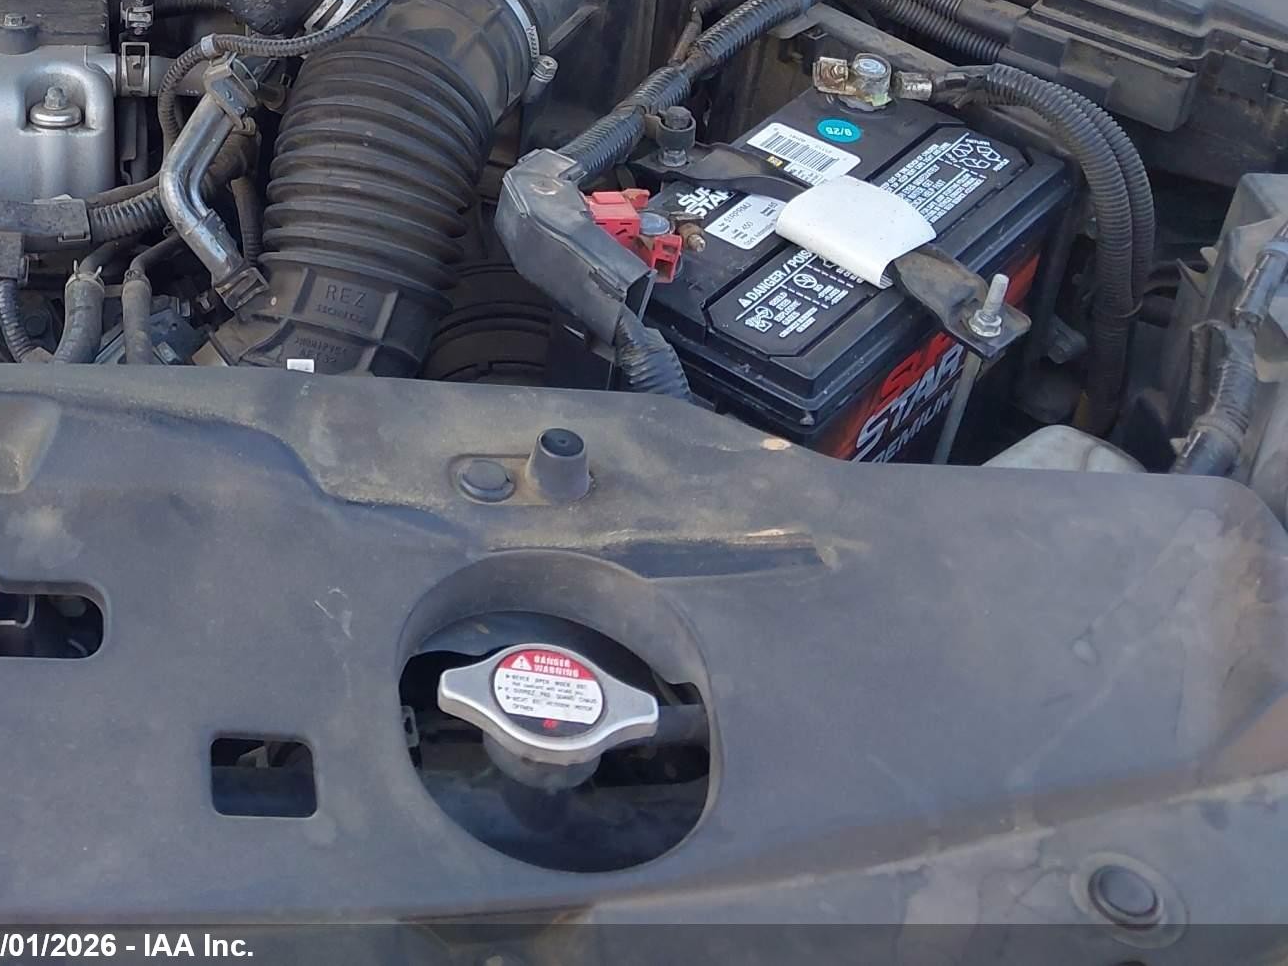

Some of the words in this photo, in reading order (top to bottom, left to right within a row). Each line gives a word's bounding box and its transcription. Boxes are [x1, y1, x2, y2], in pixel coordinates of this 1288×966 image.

[745, 270, 787, 301] DANGER
[325, 284, 368, 308] REZ
[534, 654, 571, 668] DANGER
[534, 664, 579, 678] WARNING
